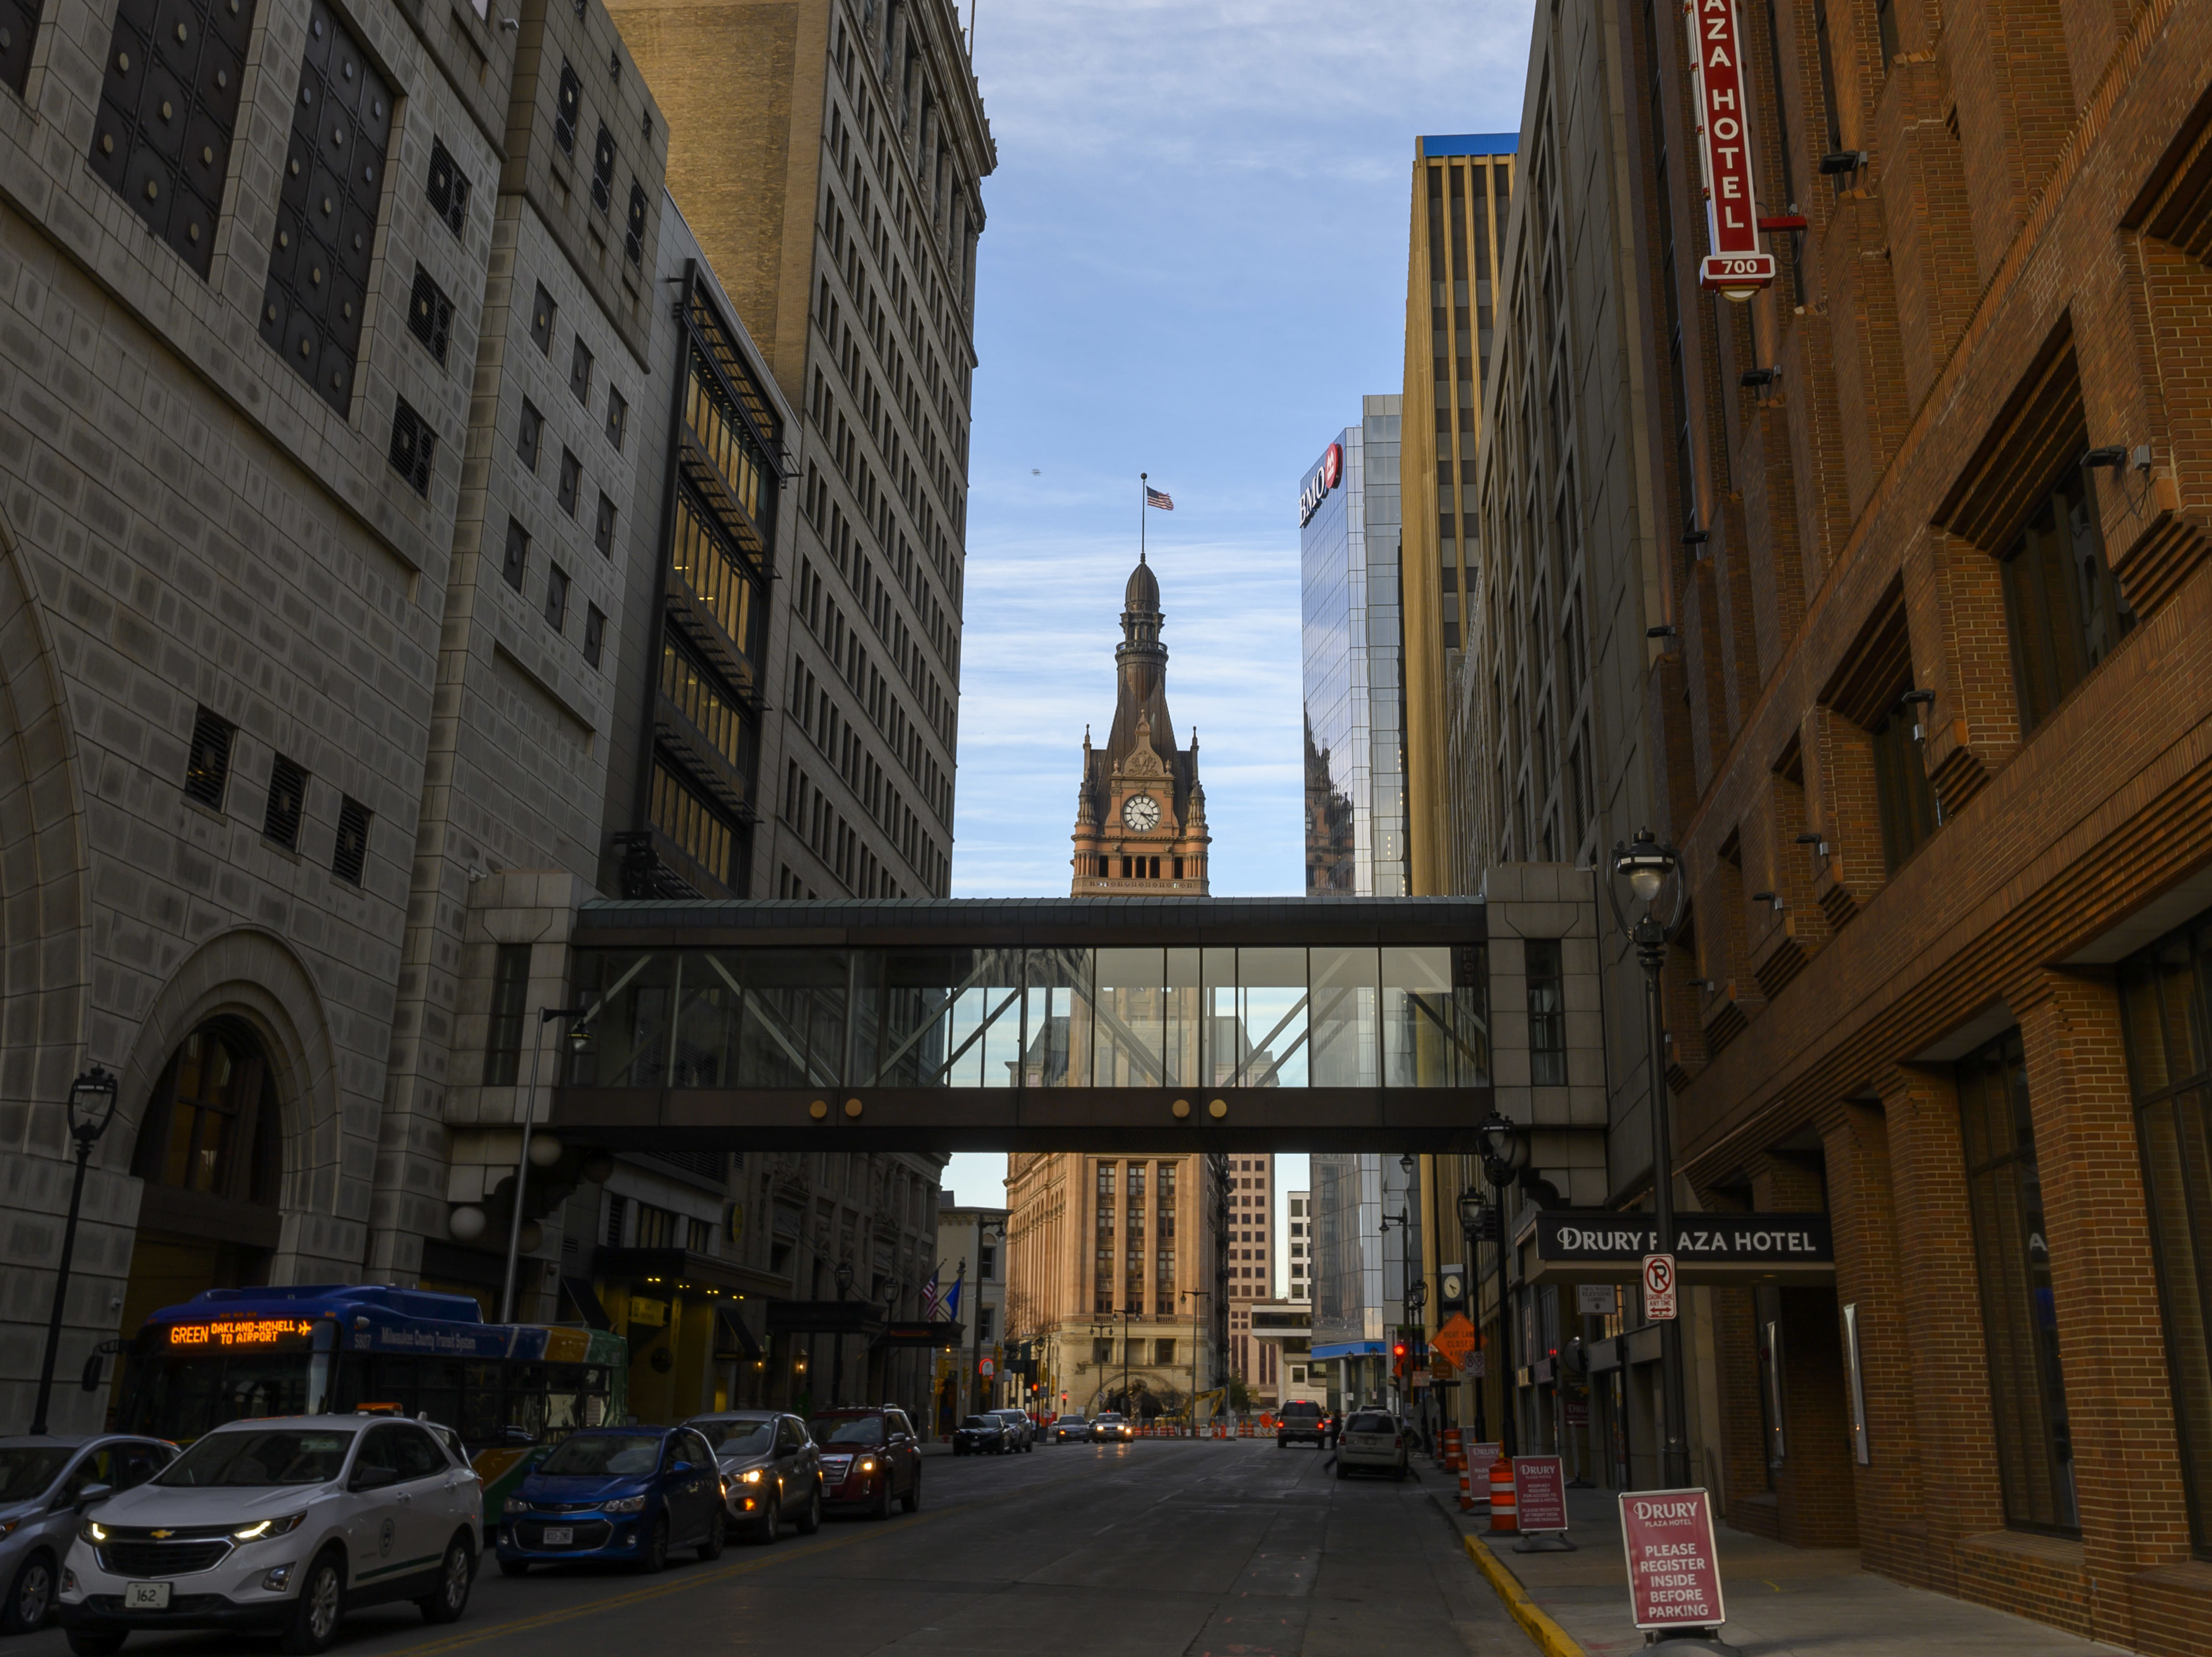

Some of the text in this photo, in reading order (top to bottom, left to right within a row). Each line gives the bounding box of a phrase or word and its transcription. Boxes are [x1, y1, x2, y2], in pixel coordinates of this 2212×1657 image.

[1712, 89, 1744, 228] HOTEL
[1722, 260, 1758, 274] 700
[1298, 466, 1325, 528] BMO
[1557, 1226, 1816, 1251] DRURY PAZA HOTEL
[211, 1320, 295, 1334] OAKLAND-HOWELL
[171, 1326, 209, 1344] GREEN
[220, 1331, 278, 1345] TO AIRPORT
[382, 1327, 476, 1353] Milwaukee County Transit System
[1567, 1404, 1587, 1414] DRU
[1520, 1465, 1555, 1475] DRURY
[1633, 1502, 1697, 1520] DRURY
[1645, 1543, 1697, 1557] PLEASE
[1640, 1558, 1705, 1573] REGISTER
[1650, 1574, 1697, 1587] INSIDE
[137, 1589, 157, 1602] 162
[1650, 1588, 1704, 1602] BEFORE
[1648, 1604, 1709, 1618] PARKING
